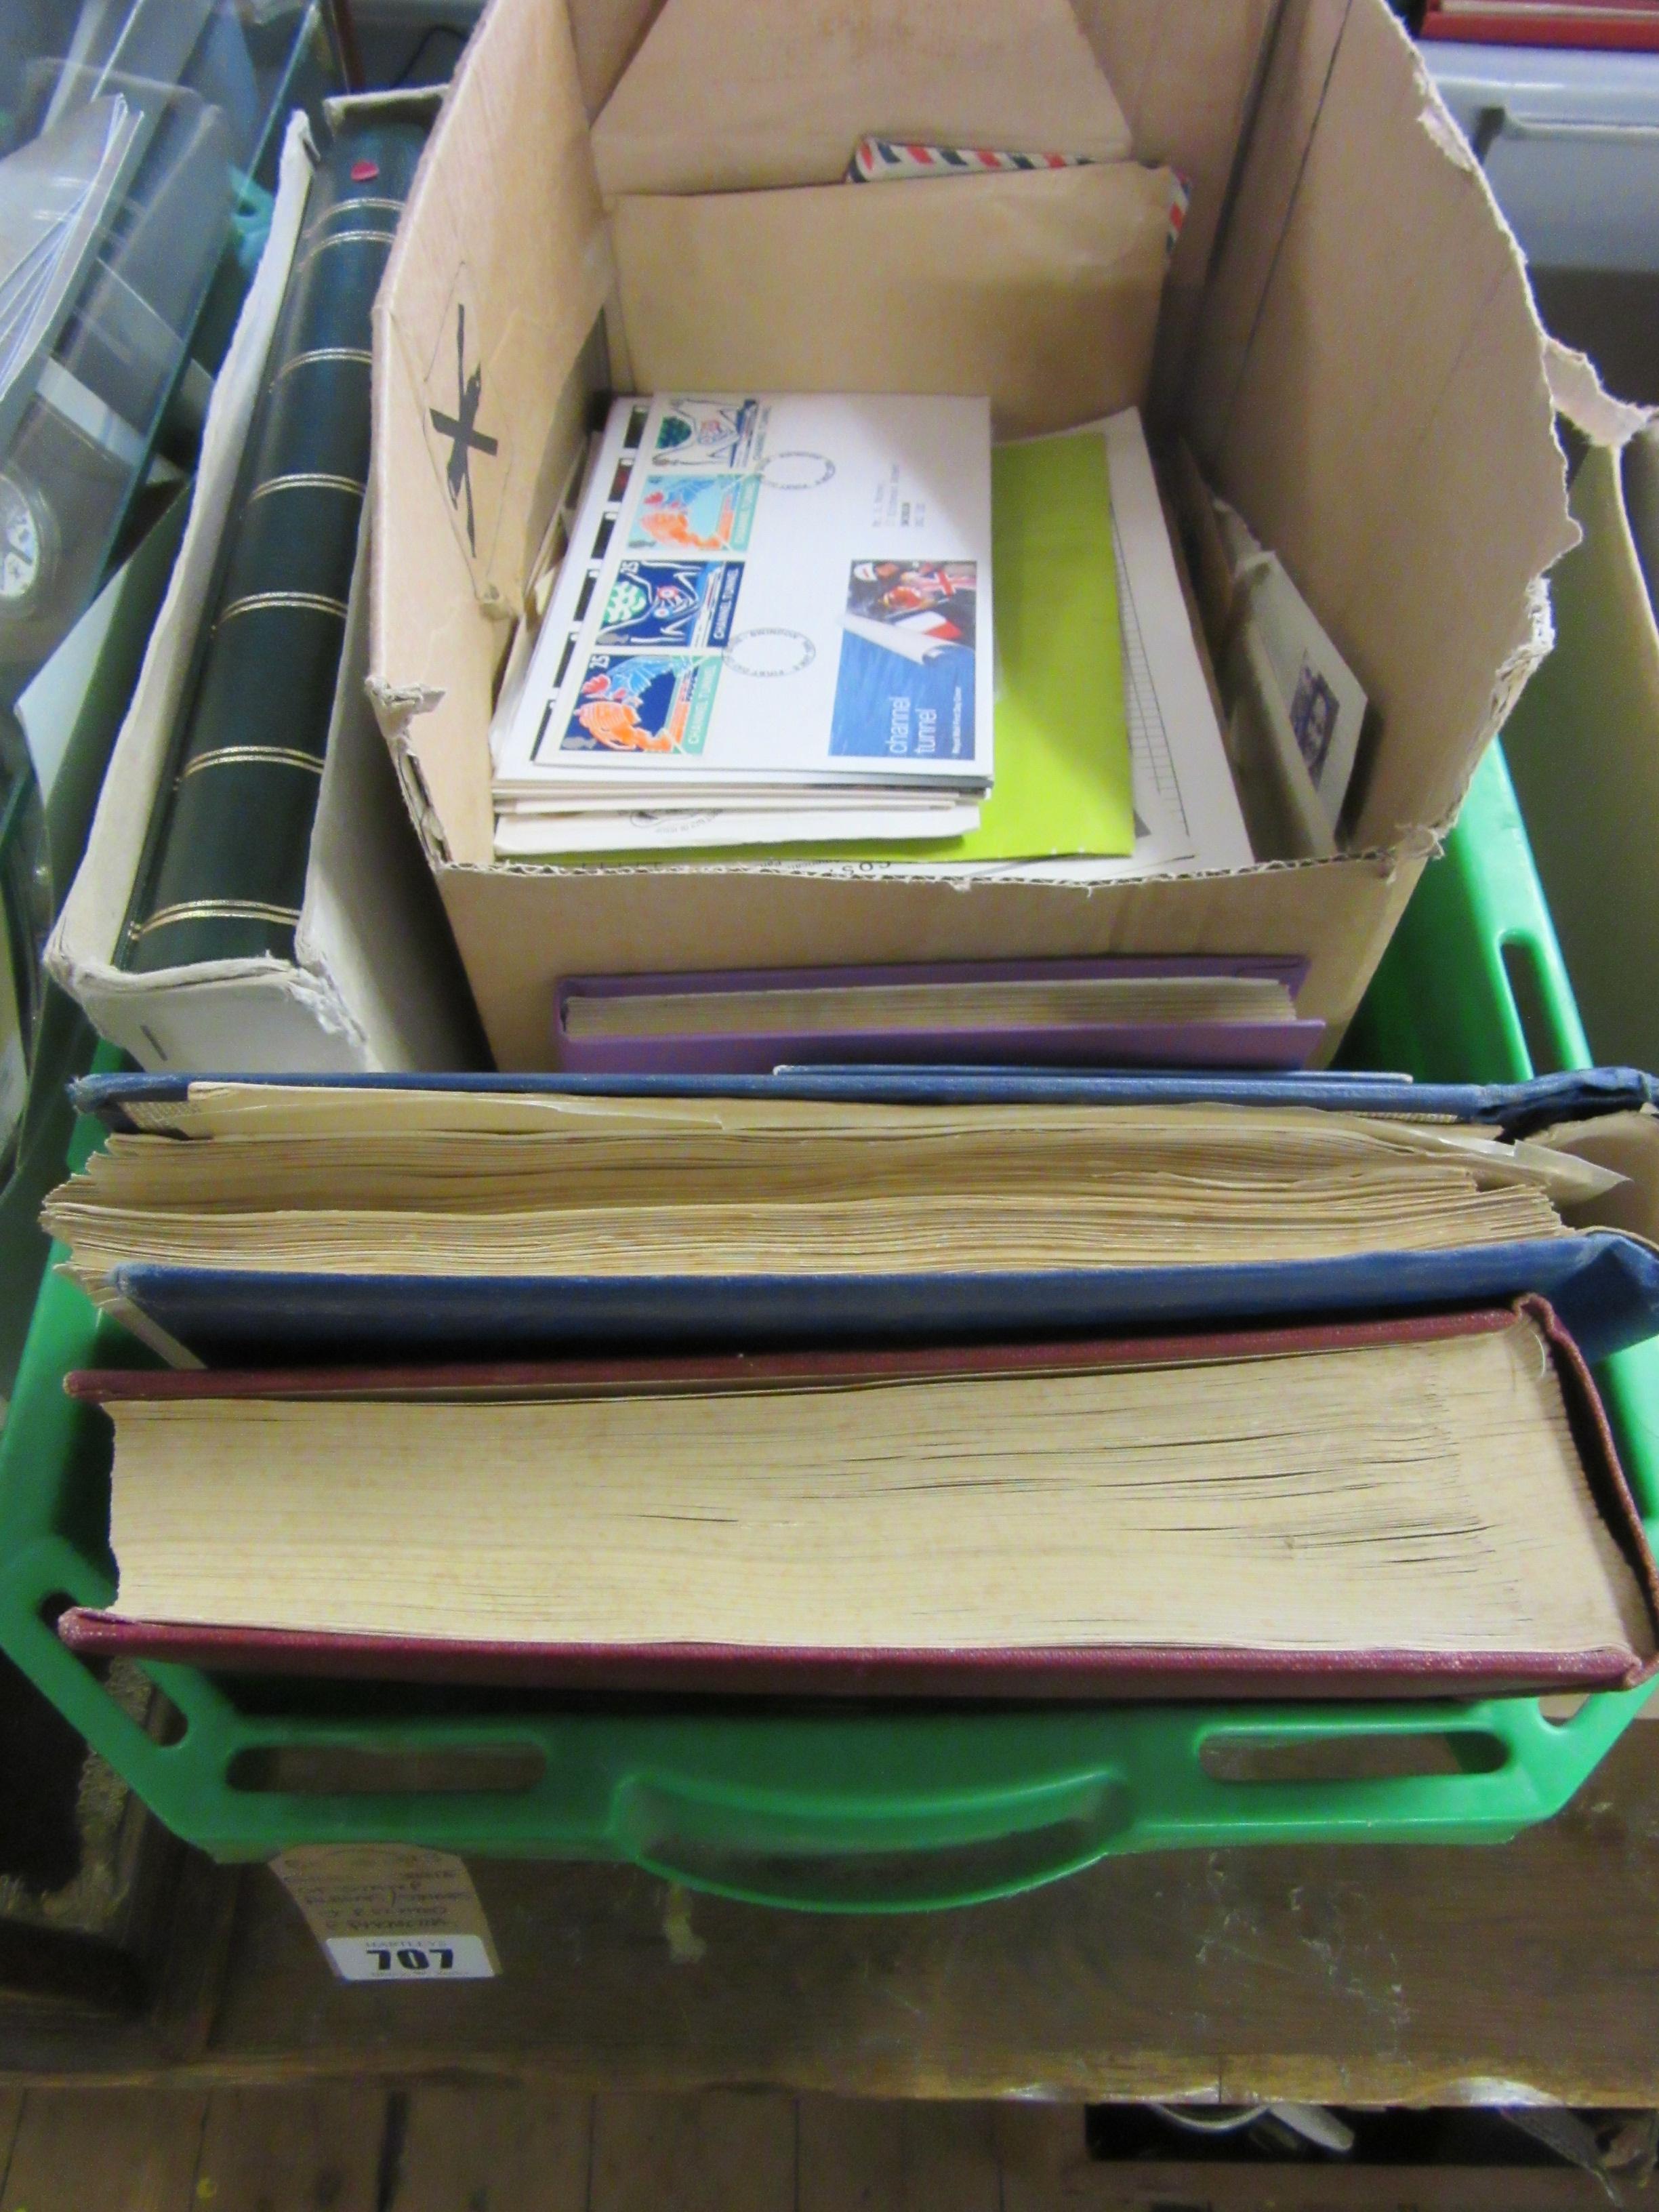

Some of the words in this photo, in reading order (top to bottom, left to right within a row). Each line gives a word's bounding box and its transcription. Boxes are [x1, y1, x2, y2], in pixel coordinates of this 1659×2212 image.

[619, 560, 640, 575] 25
[713, 600, 732, 640] CHANNEL
[589, 654, 610, 670] 25
[697, 664, 718, 701] TUNNEL
[687, 699, 709, 745] CHANNEL
[885, 696, 911, 754] channel
[914, 708, 937, 754] tunnel
[366, 1948, 453, 1970] 707
